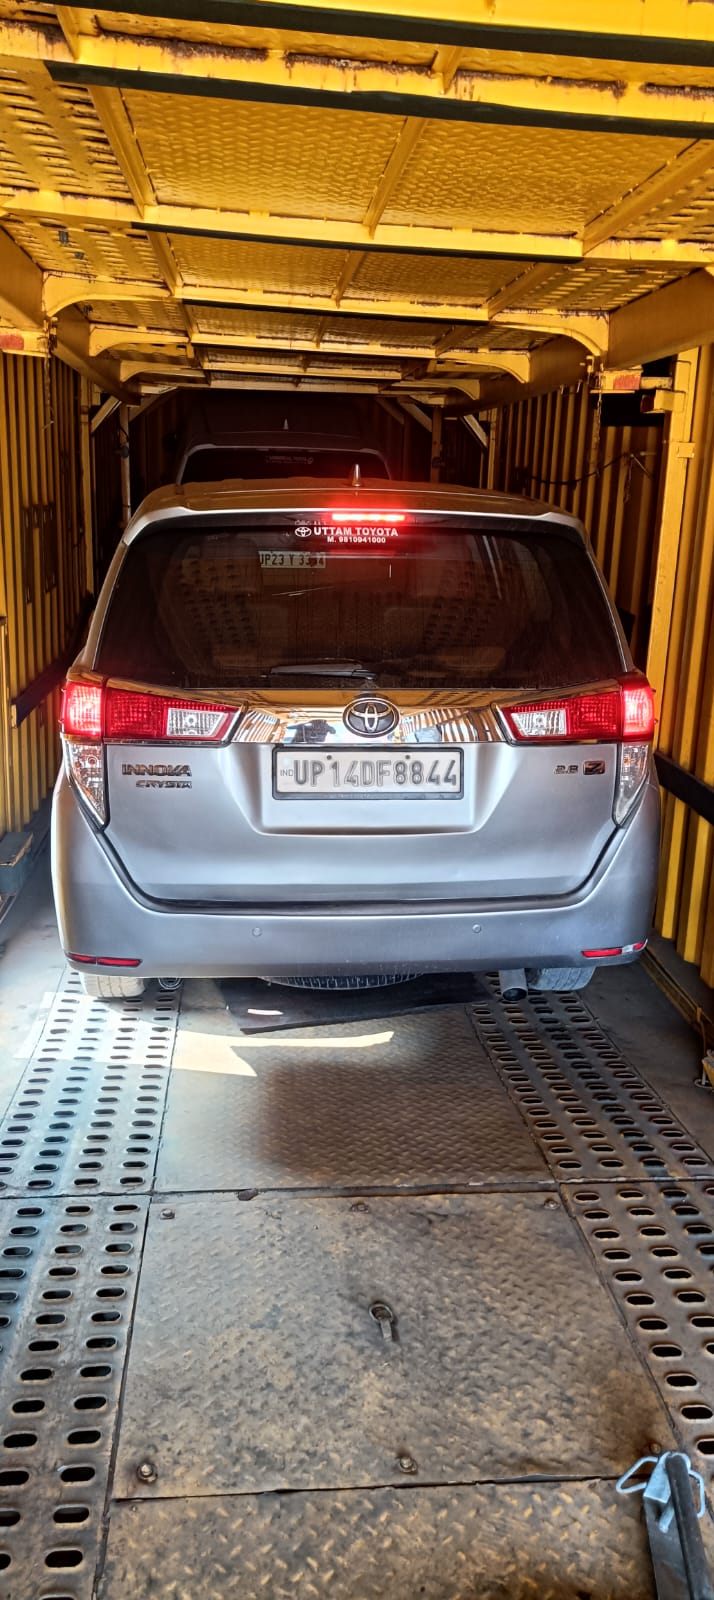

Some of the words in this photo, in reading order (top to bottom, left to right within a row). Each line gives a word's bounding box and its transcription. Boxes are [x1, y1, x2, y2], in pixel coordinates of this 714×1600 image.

[313, 526, 352, 536] UTTAM
[355, 527, 399, 537] TOYOTA
[122, 764, 192, 777] INNOVA
[280, 768, 294, 777] IND
[135, 779, 192, 789] CRYSTA
